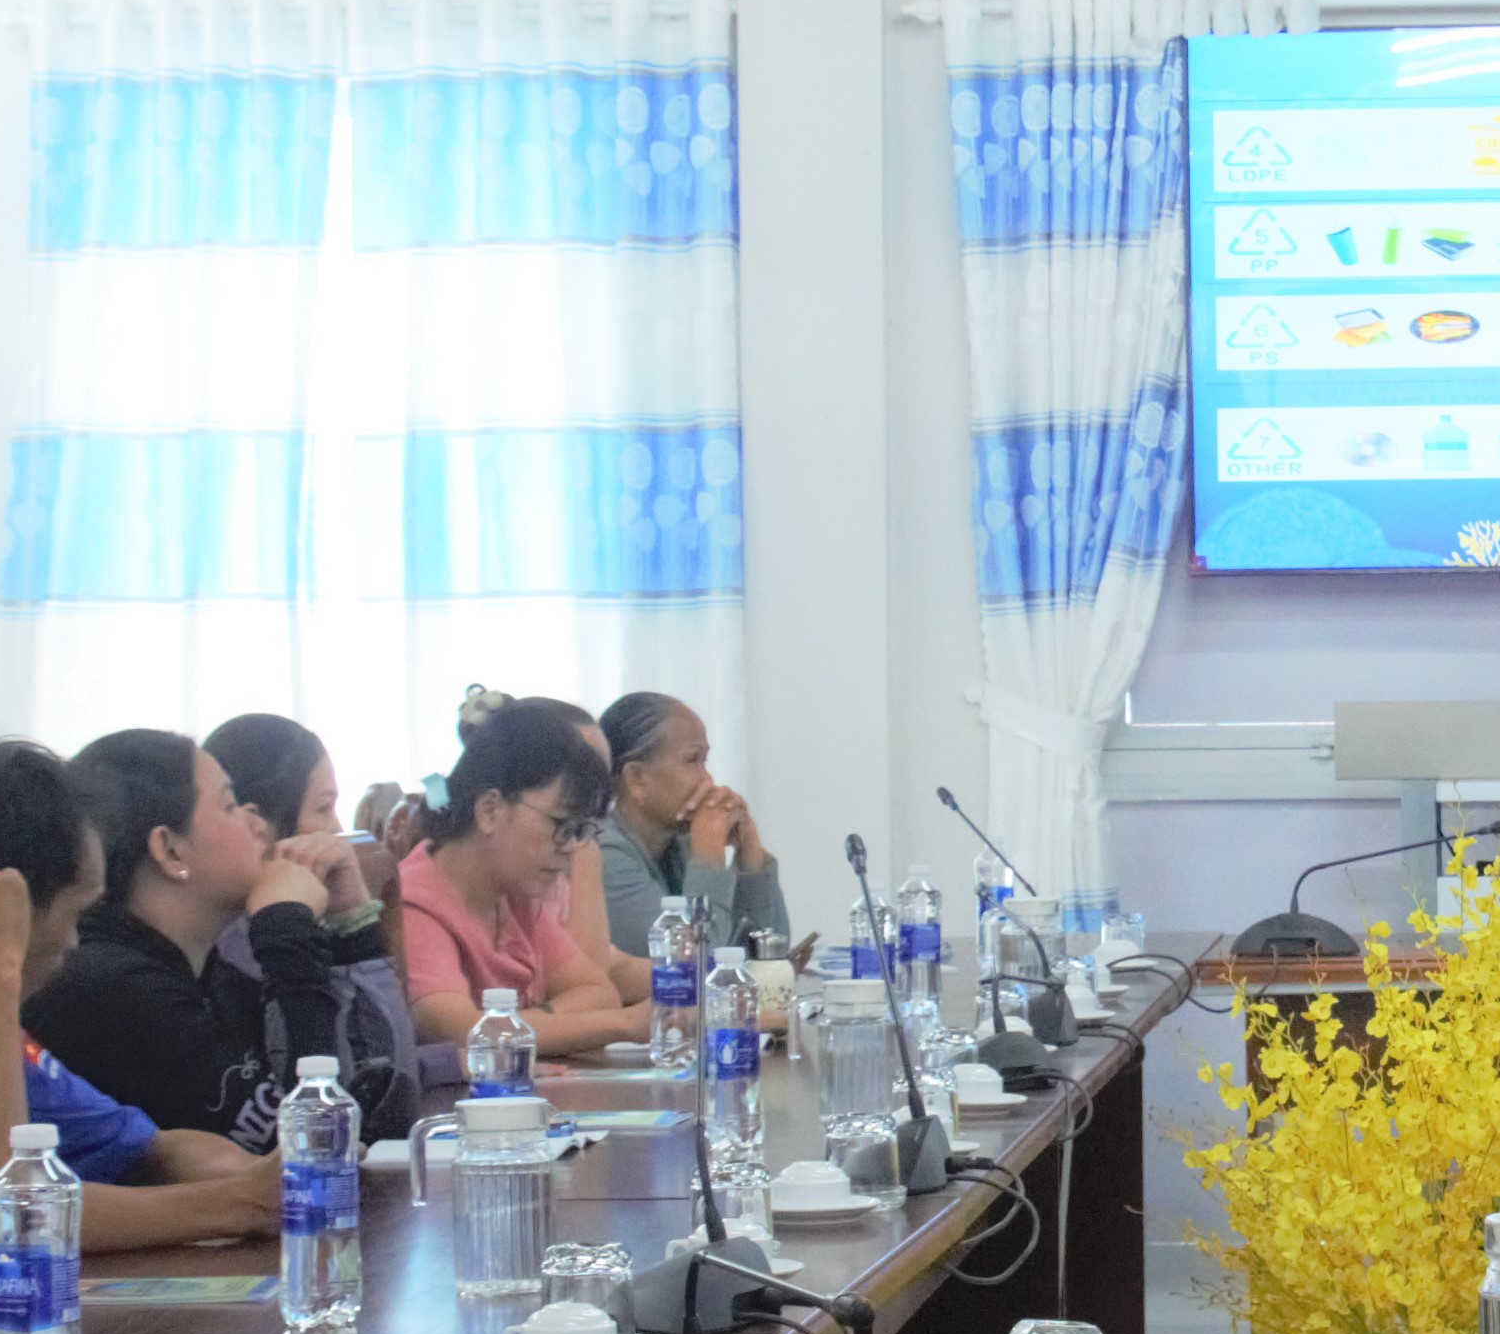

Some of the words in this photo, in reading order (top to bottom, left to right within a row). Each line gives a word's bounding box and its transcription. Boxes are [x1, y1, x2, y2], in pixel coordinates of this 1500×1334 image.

[1248, 145, 1262, 157] 4
[1228, 168, 1288, 183] LDPE
[1255, 229, 1269, 244] 5
[1250, 258, 1279, 273] PP
[1254, 323, 1269, 338] 6
[1250, 351, 1279, 366] PS
[1258, 436, 1271, 451] 7
[1227, 462, 1303, 477] OTHER
